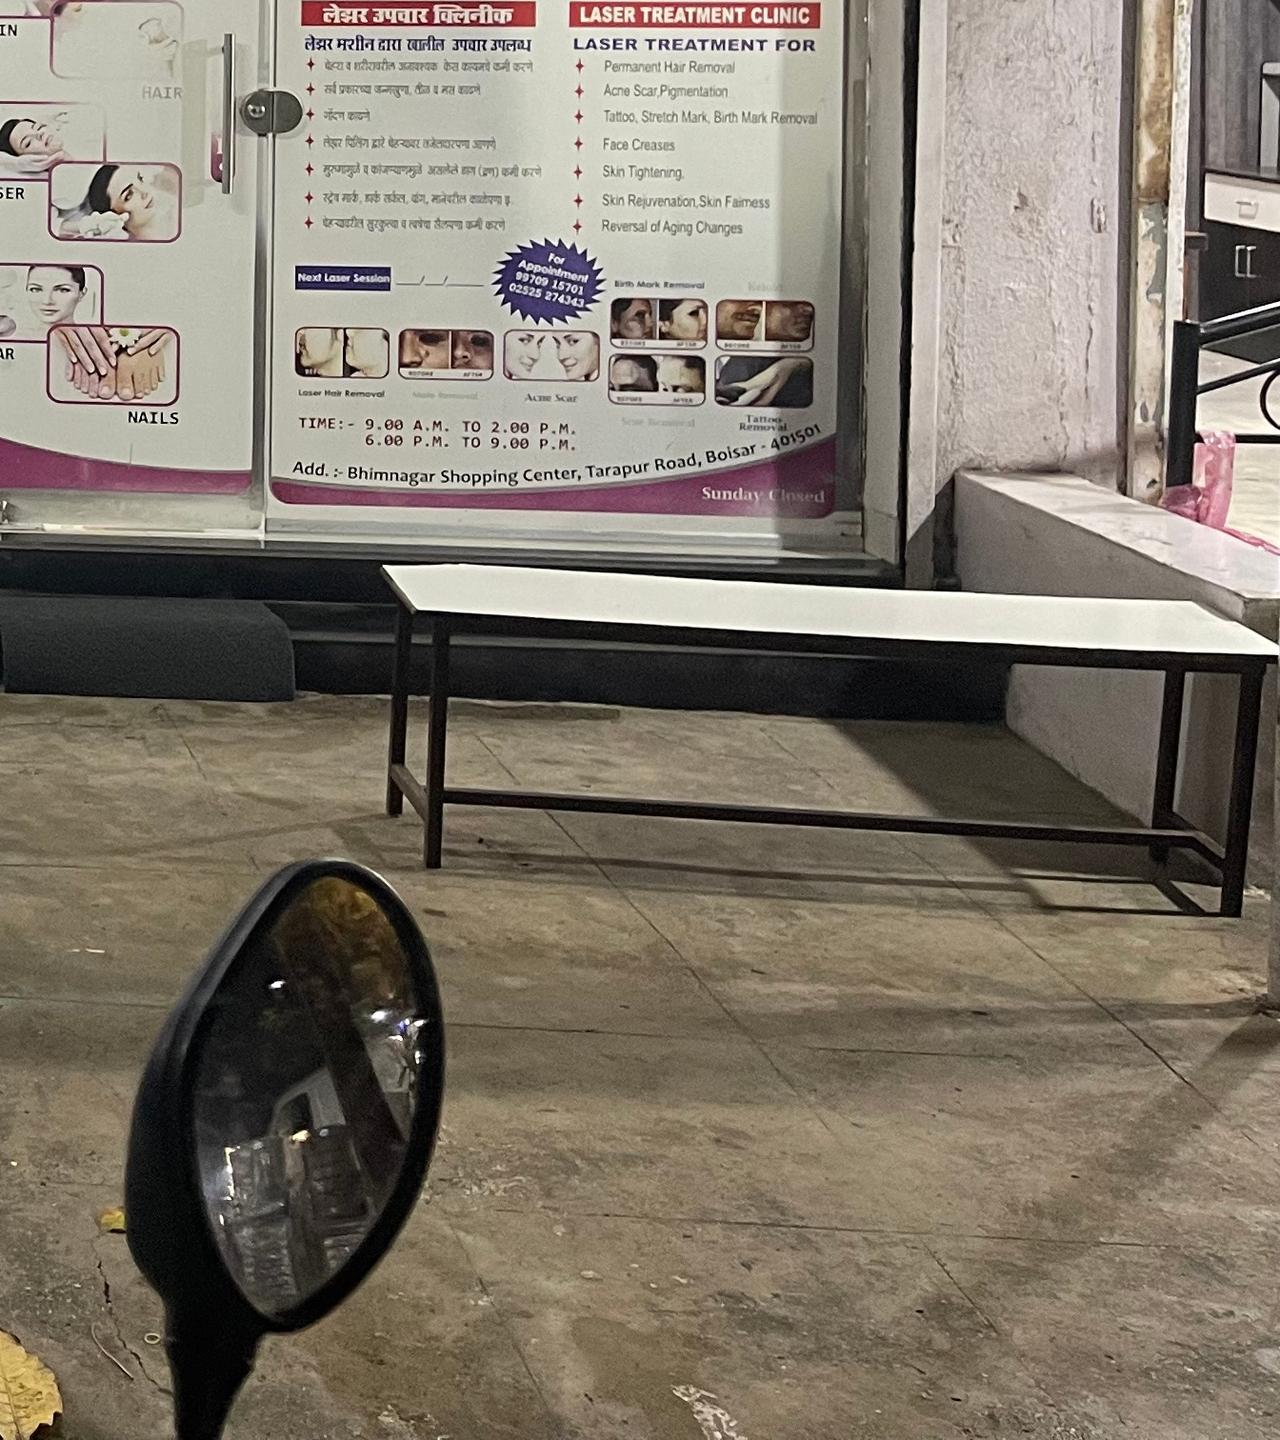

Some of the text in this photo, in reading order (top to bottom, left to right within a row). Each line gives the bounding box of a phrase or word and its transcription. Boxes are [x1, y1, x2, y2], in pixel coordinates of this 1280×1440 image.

[323, 3, 368, 26] लेझर
[372, 3, 429, 26] उपचार
[580, 6, 810, 25] LASER TREATMENT CLINIC
[337, 35, 374, 53] मशीन
[452, 35, 487, 53] उपचार
[573, 38, 816, 53] LASER TREATMENT FOR
[604, 60, 736, 74] Permanent Hair Removal
[141, 86, 183, 99] HAIR
[641, 110, 679, 125] Stretch
[713, 110, 739, 125] Birth
[741, 110, 768, 125] Mark
[770, 110, 818, 125] Removal
[603, 138, 675, 152] Face Creases
[601, 220, 743, 236] Reversal of Aging Changes
[548, 252, 566, 264] For
[297, 272, 391, 285] Next Laser Session
[517, 259, 589, 283] Appointment
[298, 389, 322, 398] Laser
[344, 389, 385, 398] Removal
[127, 412, 180, 425] NAILS
[365, 418, 404, 431] 9.00
[413, 419, 450, 432] A.M.
[462, 420, 481, 433] TO
[491, 421, 530, 434] 2.00
[539, 422, 577, 435] P.M.
[365, 435, 577, 451] 6.00 P.M. TO 9.00 P.M.
[347, 464, 436, 485] Bhimnagar
[440, 466, 519, 486] Shopping
[523, 464, 582, 484] Center,
[586, 460, 650, 480] Tarapur
[654, 452, 703, 472] Road,
[705, 442, 757, 465] Boisar
[770, 423, 823, 452] 401501
[701, 486, 762, 502] Sunday
